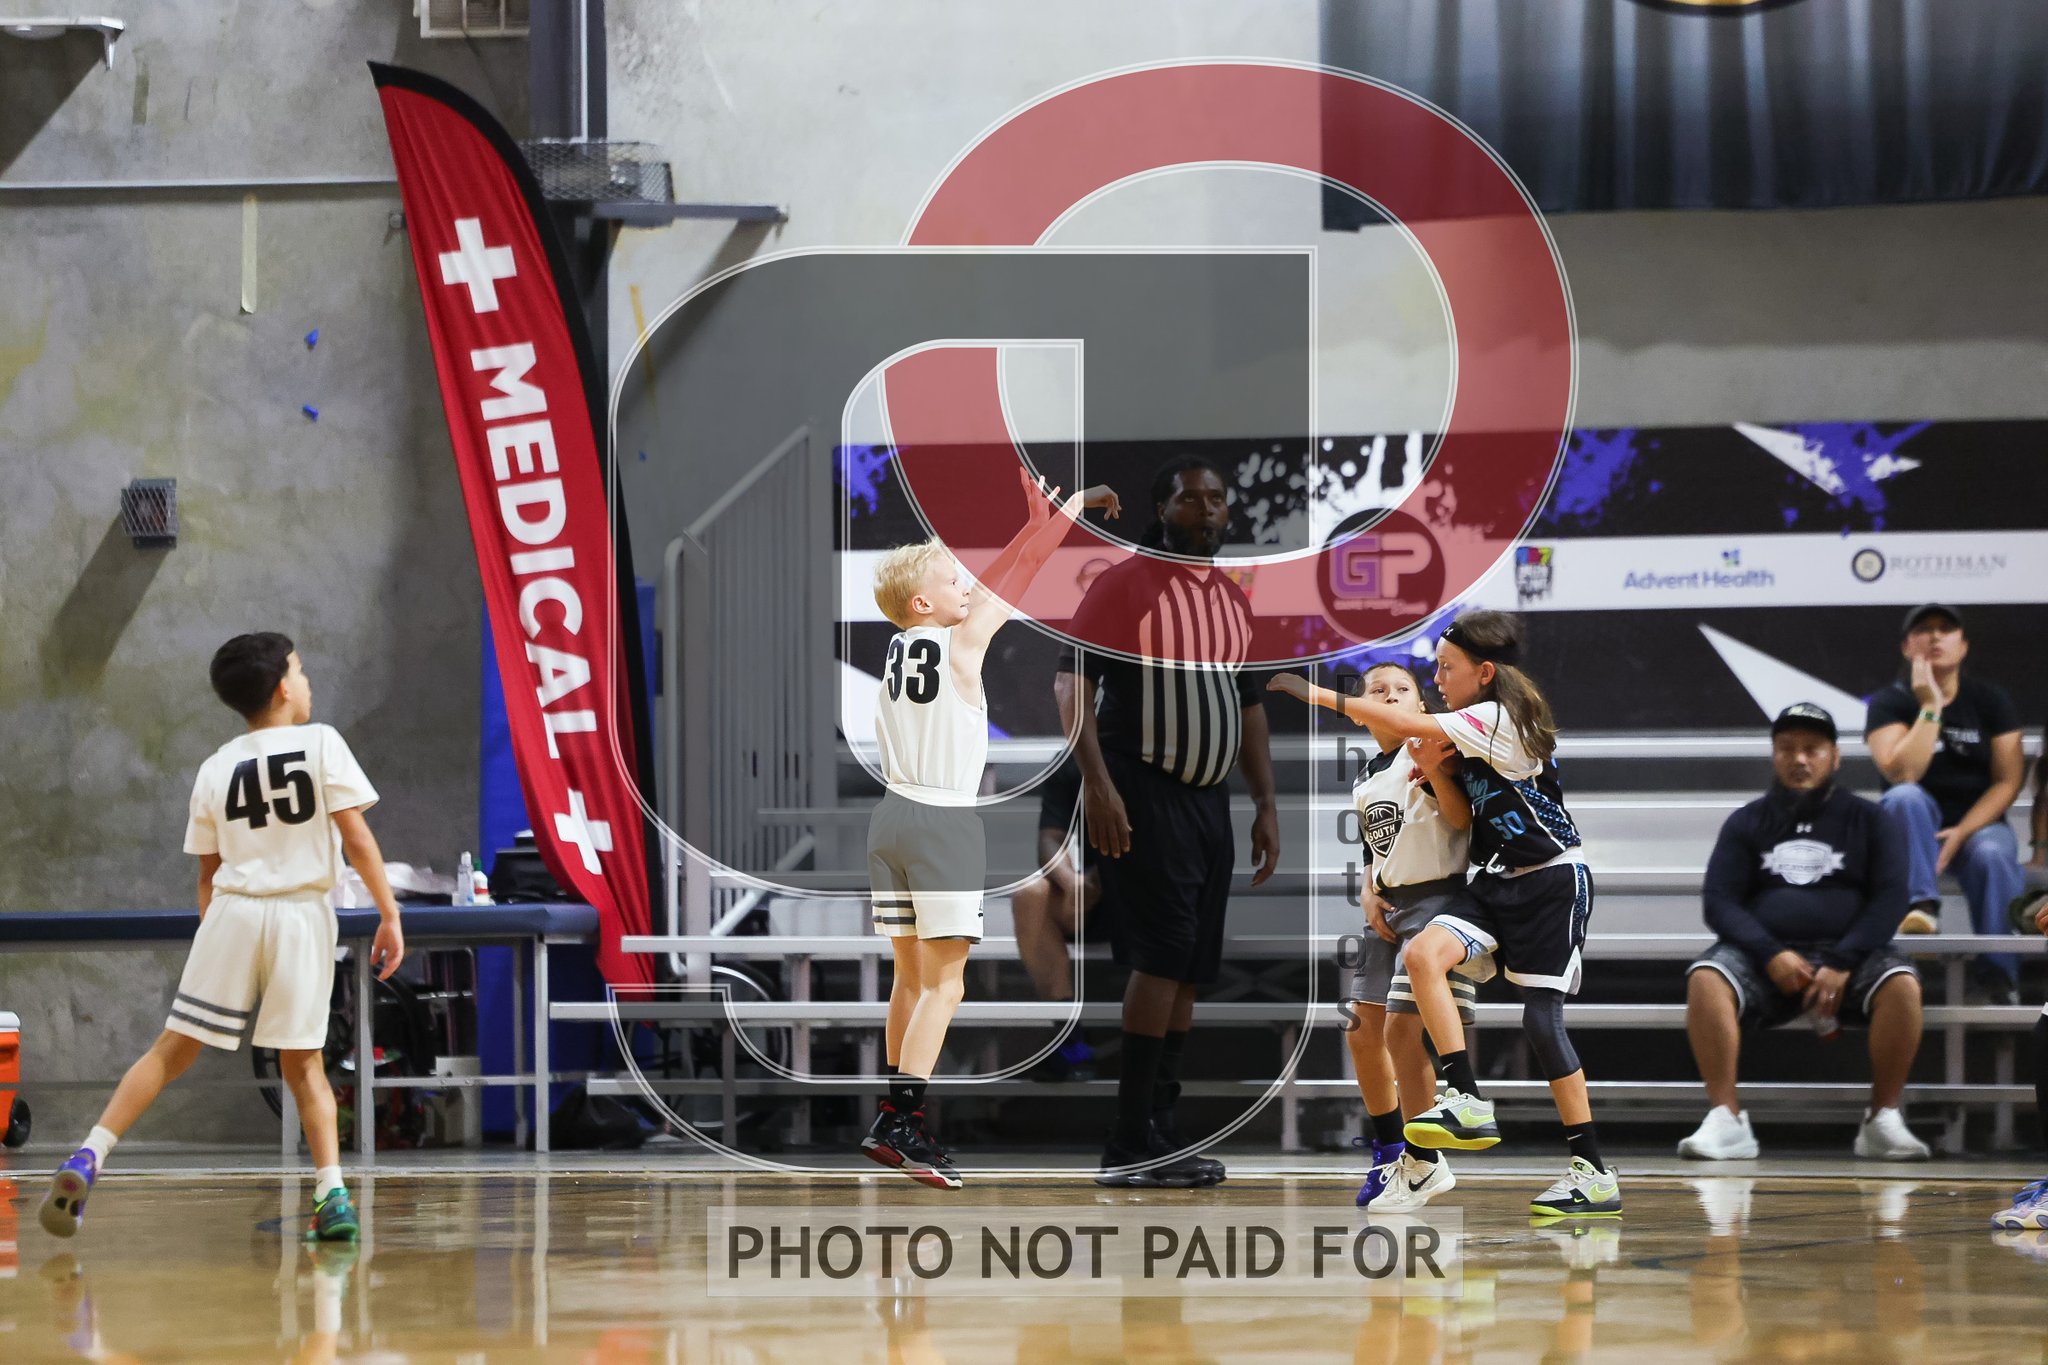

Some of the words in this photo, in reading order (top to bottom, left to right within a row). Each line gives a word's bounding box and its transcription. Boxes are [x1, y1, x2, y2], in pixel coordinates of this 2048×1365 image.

[470, 342, 597, 759] MEDICAL
[1329, 532, 1432, 599] GP
[1890, 555, 2008, 571] ROTHMAN
[887, 638, 941, 704] 33
[225, 750, 316, 830] 45
[1368, 823, 1396, 841] SOUTH
[1488, 810, 1527, 840] 50
